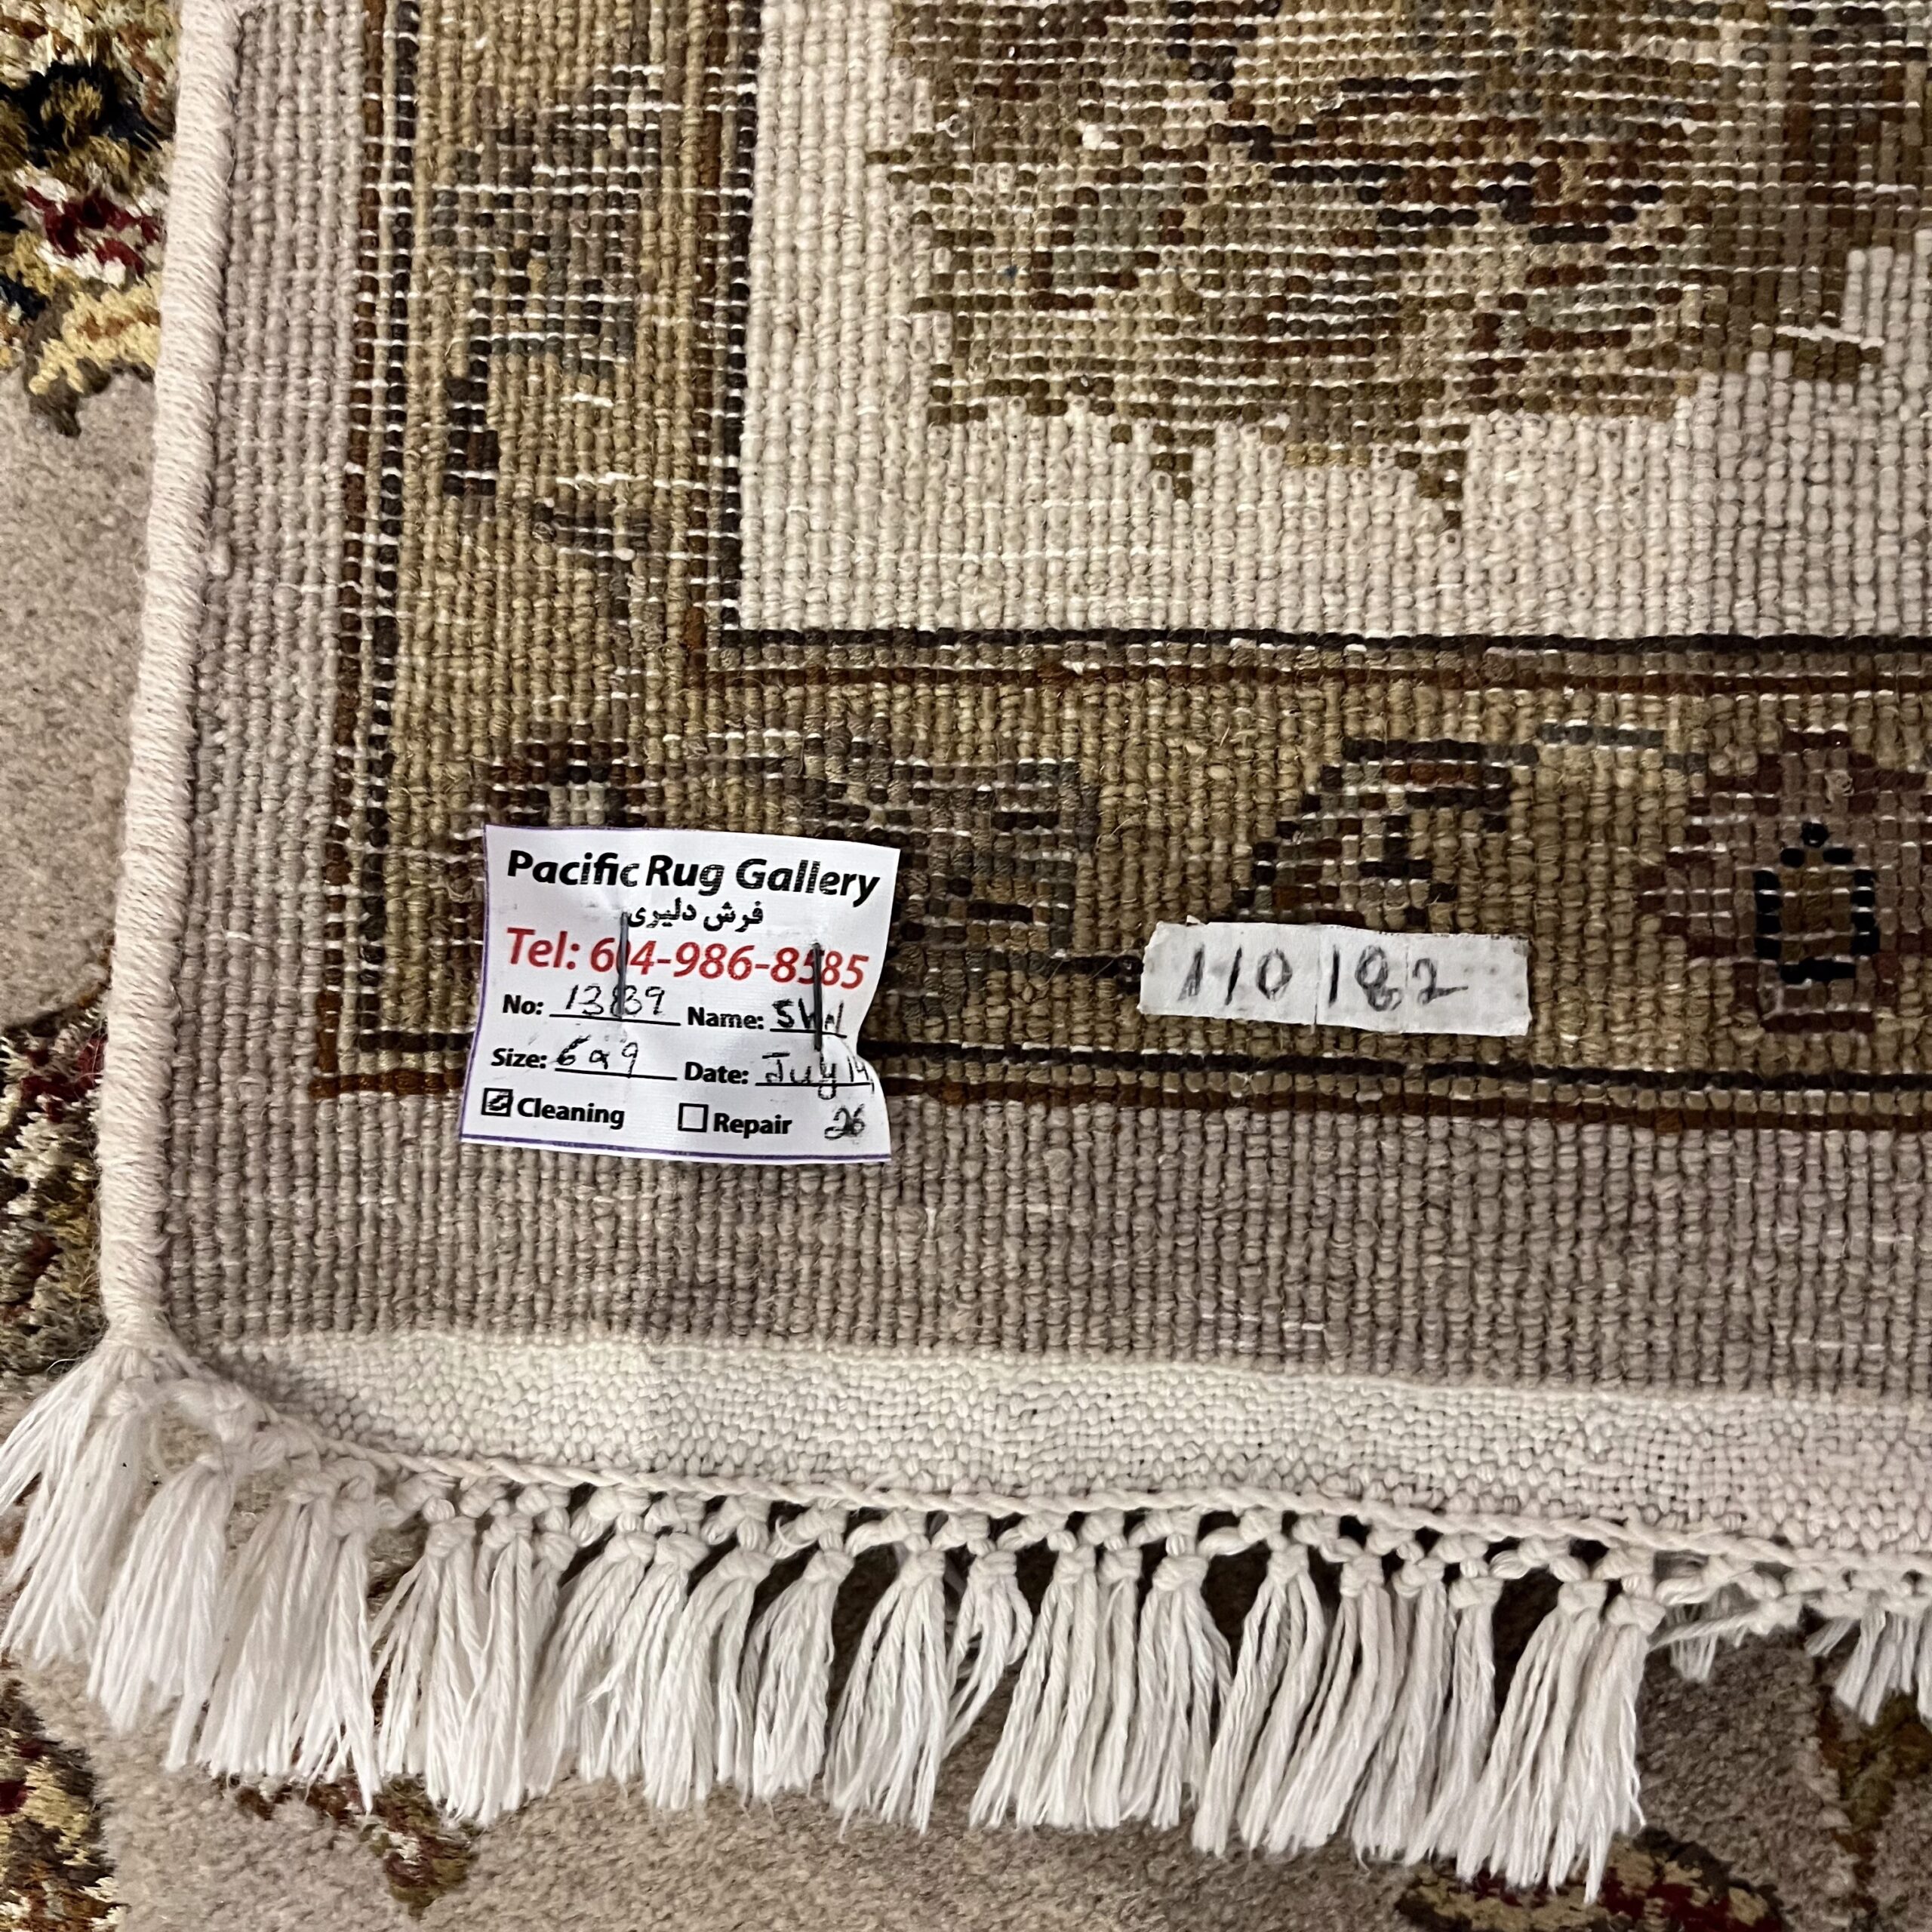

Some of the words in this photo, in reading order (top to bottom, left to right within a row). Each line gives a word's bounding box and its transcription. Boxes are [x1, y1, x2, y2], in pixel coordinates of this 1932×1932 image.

[507, 850, 639, 887] Pacific
[645, 854, 724, 896] Rug
[735, 858, 881, 907] Gallery
[703, 900, 764, 932] فرش
[506, 927, 580, 970] Tel:
[503, 994, 543, 1015] No:
[688, 1006, 764, 1029] Name:
[491, 1048, 547, 1069] Size:
[685, 1061, 749, 1084] Date:
[517, 1097, 625, 1130] Cleaning
[713, 1112, 792, 1139] Repair
